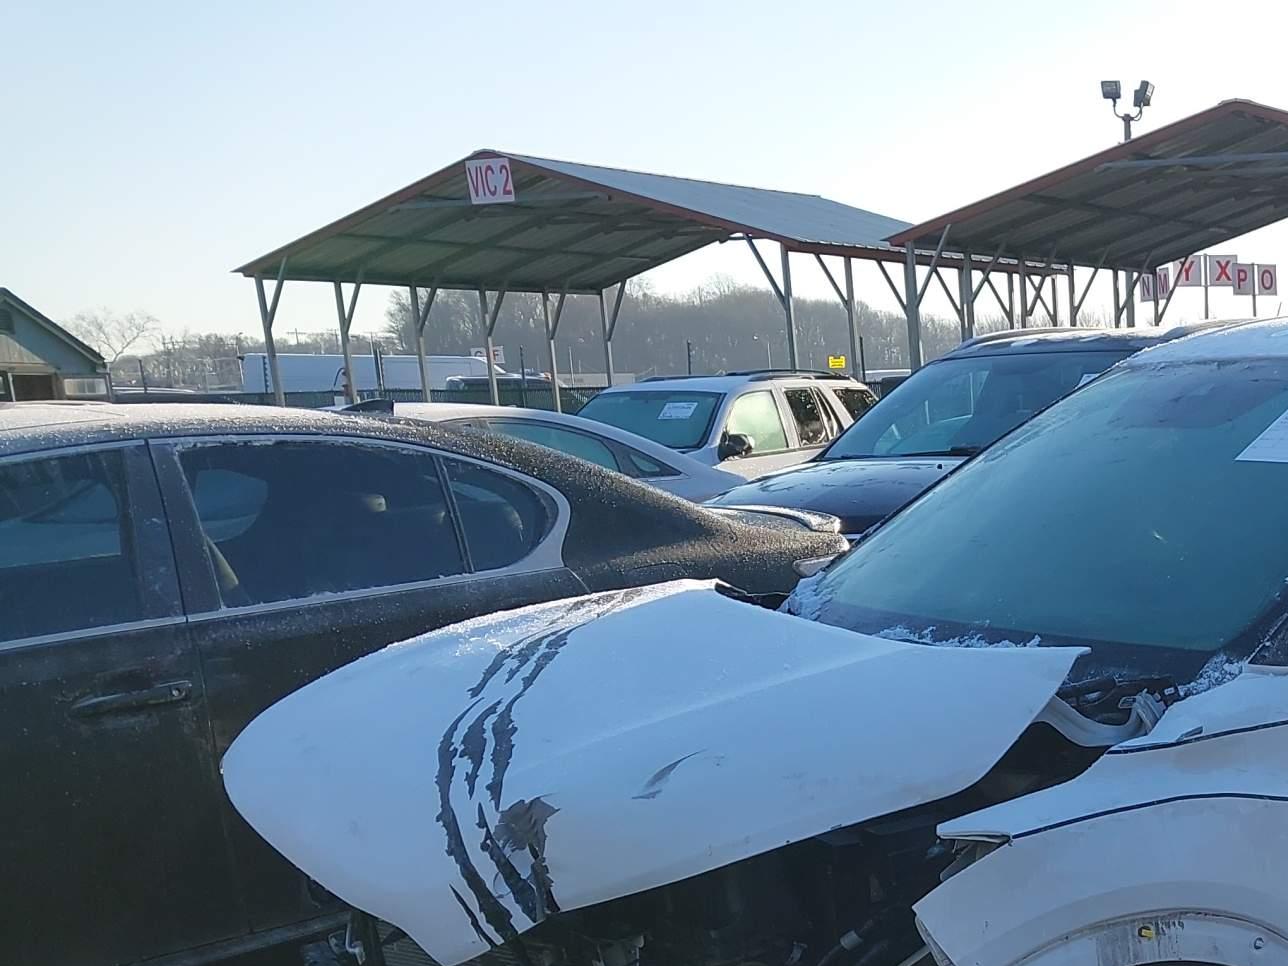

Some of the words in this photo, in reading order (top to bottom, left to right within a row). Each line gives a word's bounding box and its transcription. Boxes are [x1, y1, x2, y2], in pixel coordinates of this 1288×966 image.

[467, 165, 497, 197] VIC
[500, 165, 512, 195] 2
[1215, 260, 1232, 282] X
[1237, 268, 1248, 290] P
[1142, 275, 1152, 298] N
[1158, 272, 1169, 295] M
